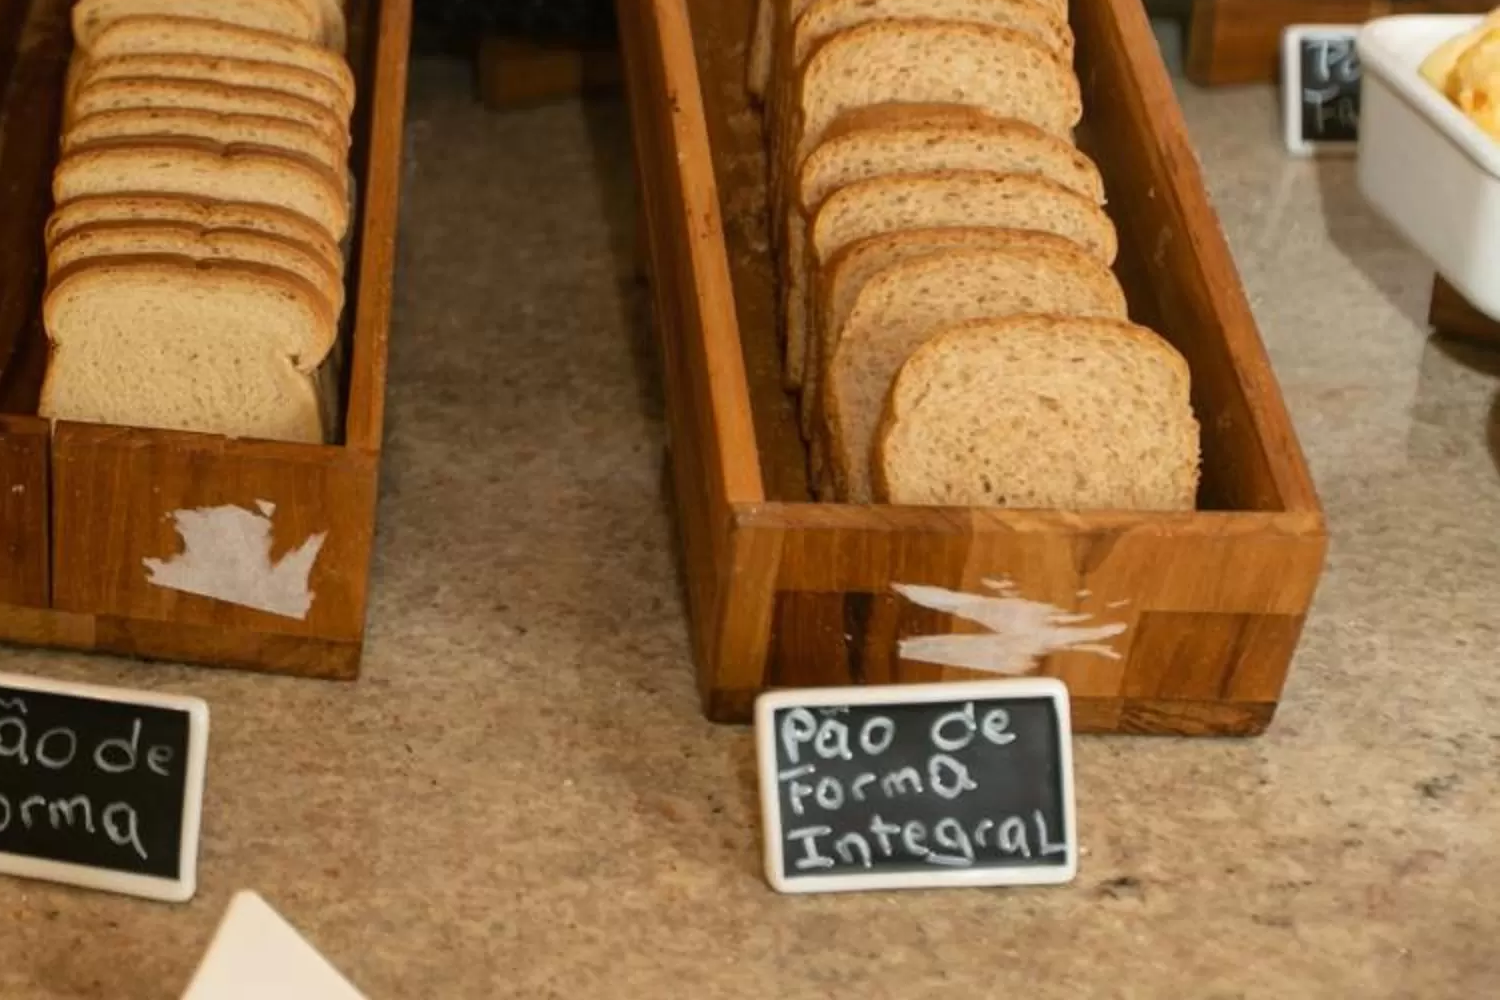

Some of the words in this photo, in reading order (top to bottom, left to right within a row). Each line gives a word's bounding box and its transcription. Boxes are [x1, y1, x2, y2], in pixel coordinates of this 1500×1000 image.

[93, 718, 174, 777] de
[930, 701, 1017, 752] de
[778, 753, 978, 815] Forma
